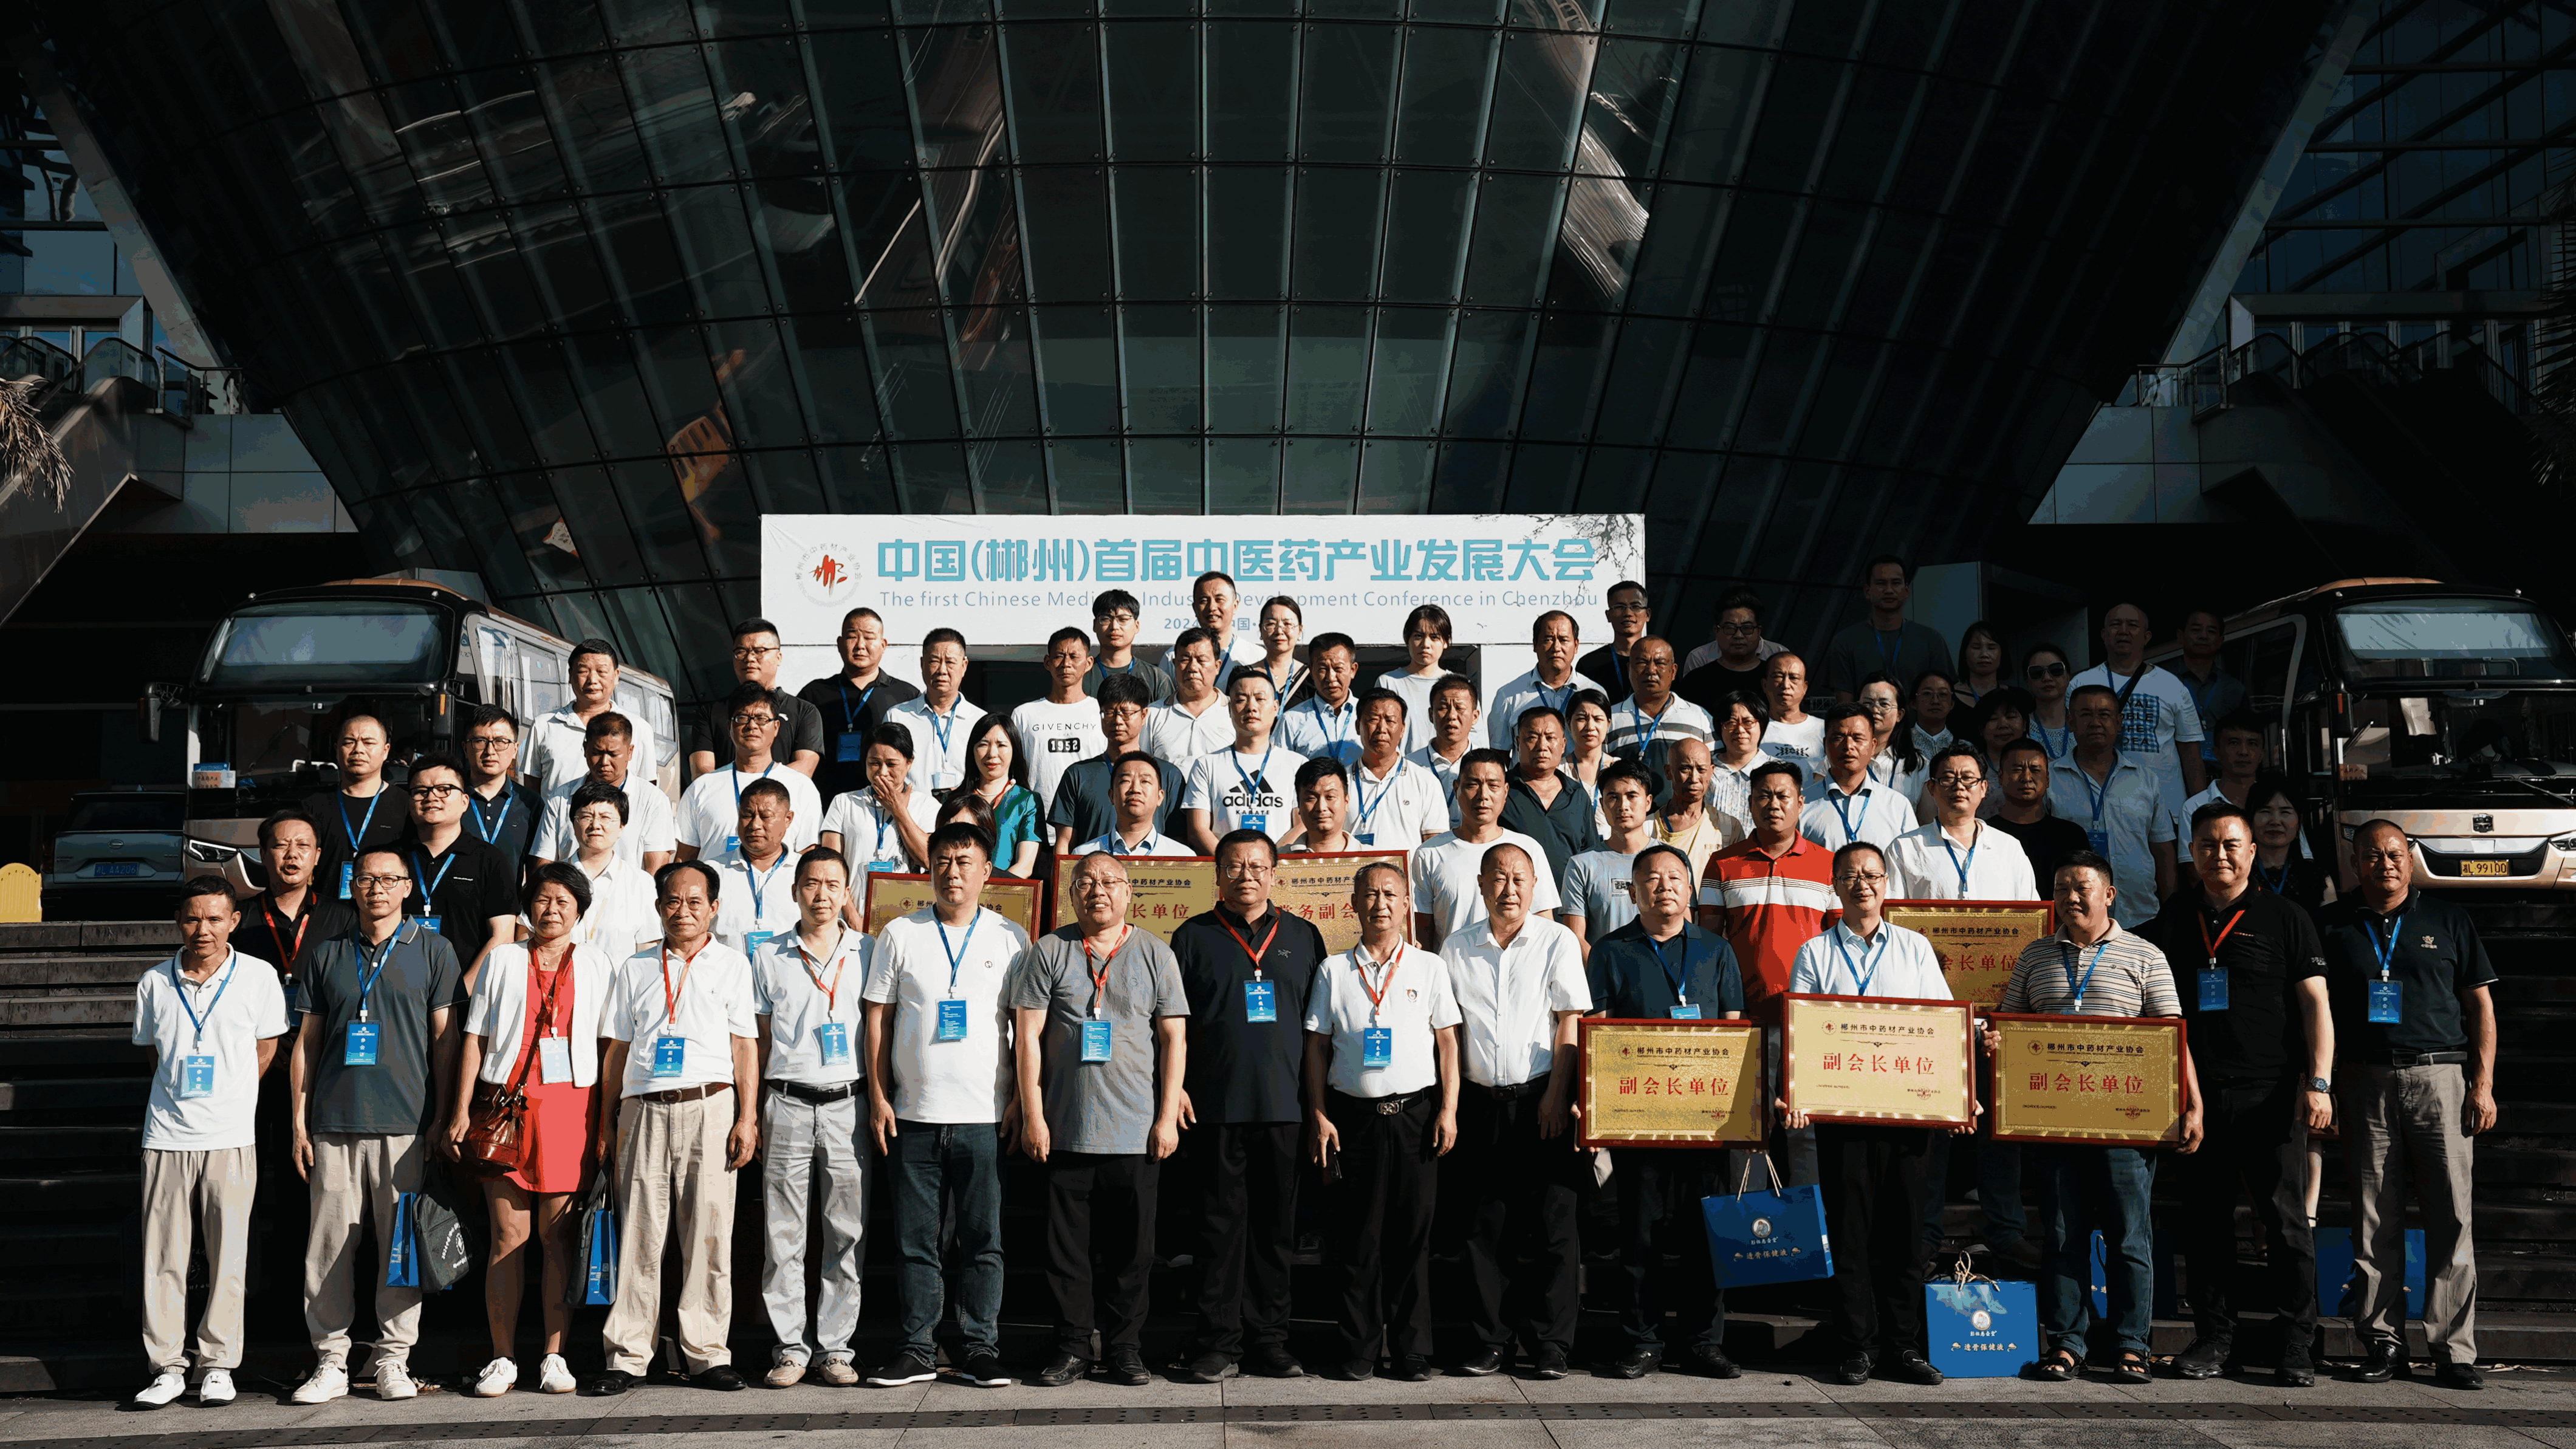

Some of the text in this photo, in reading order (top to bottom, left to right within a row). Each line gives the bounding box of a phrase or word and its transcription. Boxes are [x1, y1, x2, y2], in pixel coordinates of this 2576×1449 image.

[880, 591, 914, 606] The
[921, 591, 958, 606] first
[965, 591, 1041, 606] Chinese
[1048, 591, 1095, 606] Medi
[1143, 591, 1194, 606] Indus
[1364, 591, 1473, 606] Conference
[1481, 591, 1495, 606] in
[1502, 591, 1598, 606] Chenzhou
[2127, 699, 2153, 709] YAL
[2122, 712, 2154, 722] BLE
[1032, 722, 1097, 731] GIVENCHY
[1050, 739, 1078, 752] 1952
[2123, 736, 2150, 745] DEA
[1222, 793, 1283, 808] adidas
[1129, 878, 1191, 886] 中药材产业协会
[1292, 876, 1355, 885] 郴州市中药材产
[1130, 903, 1190, 920] 长单位
[1932, 927, 2019, 935] 郴州市中药材产业协会
[1940, 954, 2017, 972] 会长单位
[1840, 1023, 1935, 1035] 郴州市中药材产业协会
[1636, 1047, 1730, 1056] 郴州市中药材产业协会
[2047, 1043, 2144, 1054] 郴州市中药材产业协会
[1823, 1052, 1934, 1075] 副会长单位
[1619, 1076, 1729, 1096] 副会长单位
[2029, 1072, 2144, 1094] 副会长单位
